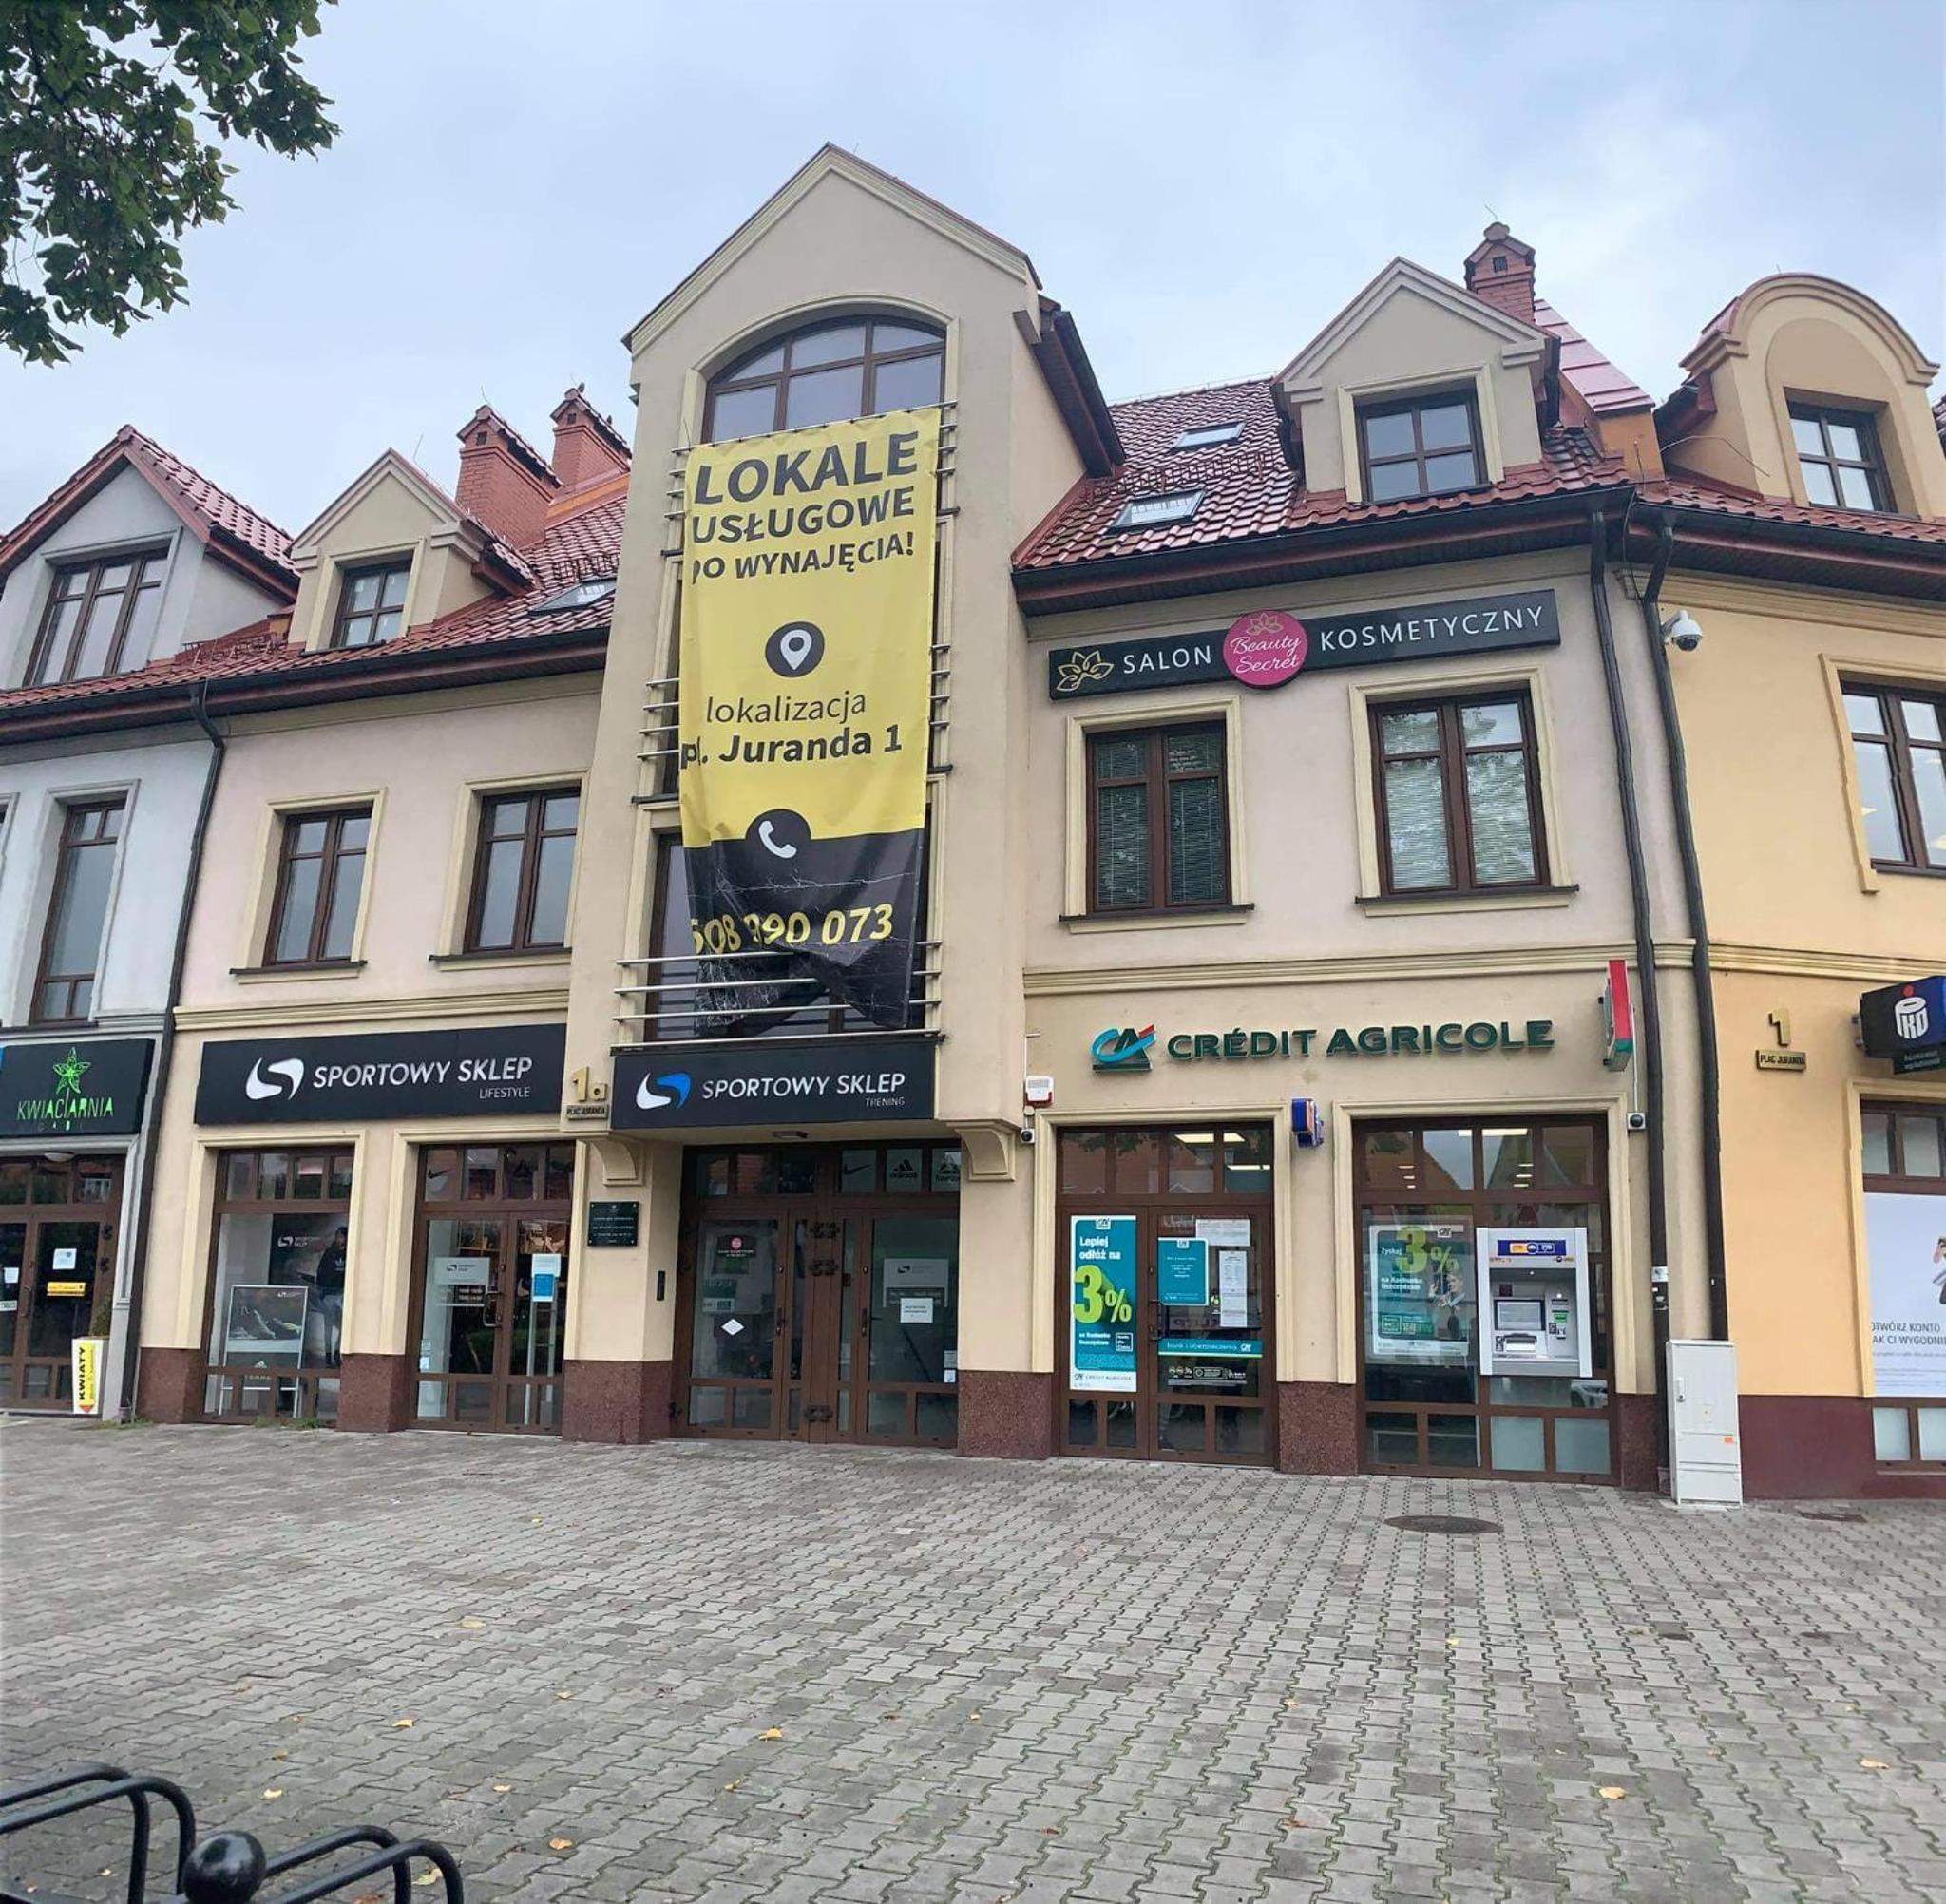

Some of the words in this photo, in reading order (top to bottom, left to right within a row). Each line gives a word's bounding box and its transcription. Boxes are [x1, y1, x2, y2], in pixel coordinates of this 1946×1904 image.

[694, 430, 919, 505] LOKALE
[692, 486, 915, 544] USŁUGOWE
[735, 531, 914, 581] WYNAJĘCIA!
[1123, 645, 1211, 675] SALON
[1321, 605, 1543, 652] KOSMETYCZNY
[1230, 634, 1302, 656] Beauty
[1235, 656, 1300, 674] Secret
[706, 690, 867, 725] lokalizacja
[718, 727, 872, 764] Juranda
[884, 724, 903, 753] 1
[820, 903, 894, 945] 073
[1167, 1026, 1318, 1060] CRÉDIT
[1326, 1020, 1555, 1057] AGRICOLE
[1768, 1007, 1791, 1047] 1
[313, 1059, 451, 1089] SPORTOWY
[457, 1057, 533, 1083] SKLEP
[701, 1076, 830, 1099] SPORTOWY
[836, 1072, 906, 1095] SKLEP
[16, 1095, 114, 1120] KWIACIARNIA
[479, 1086, 531, 1099] LIFESTYLE
[865, 1096, 906, 1107] TRENING
[1079, 1235, 1109, 1248] Lepiej
[1073, 1264, 1132, 1323] 3%
[1908, 1322, 1941, 1332] KONTO
